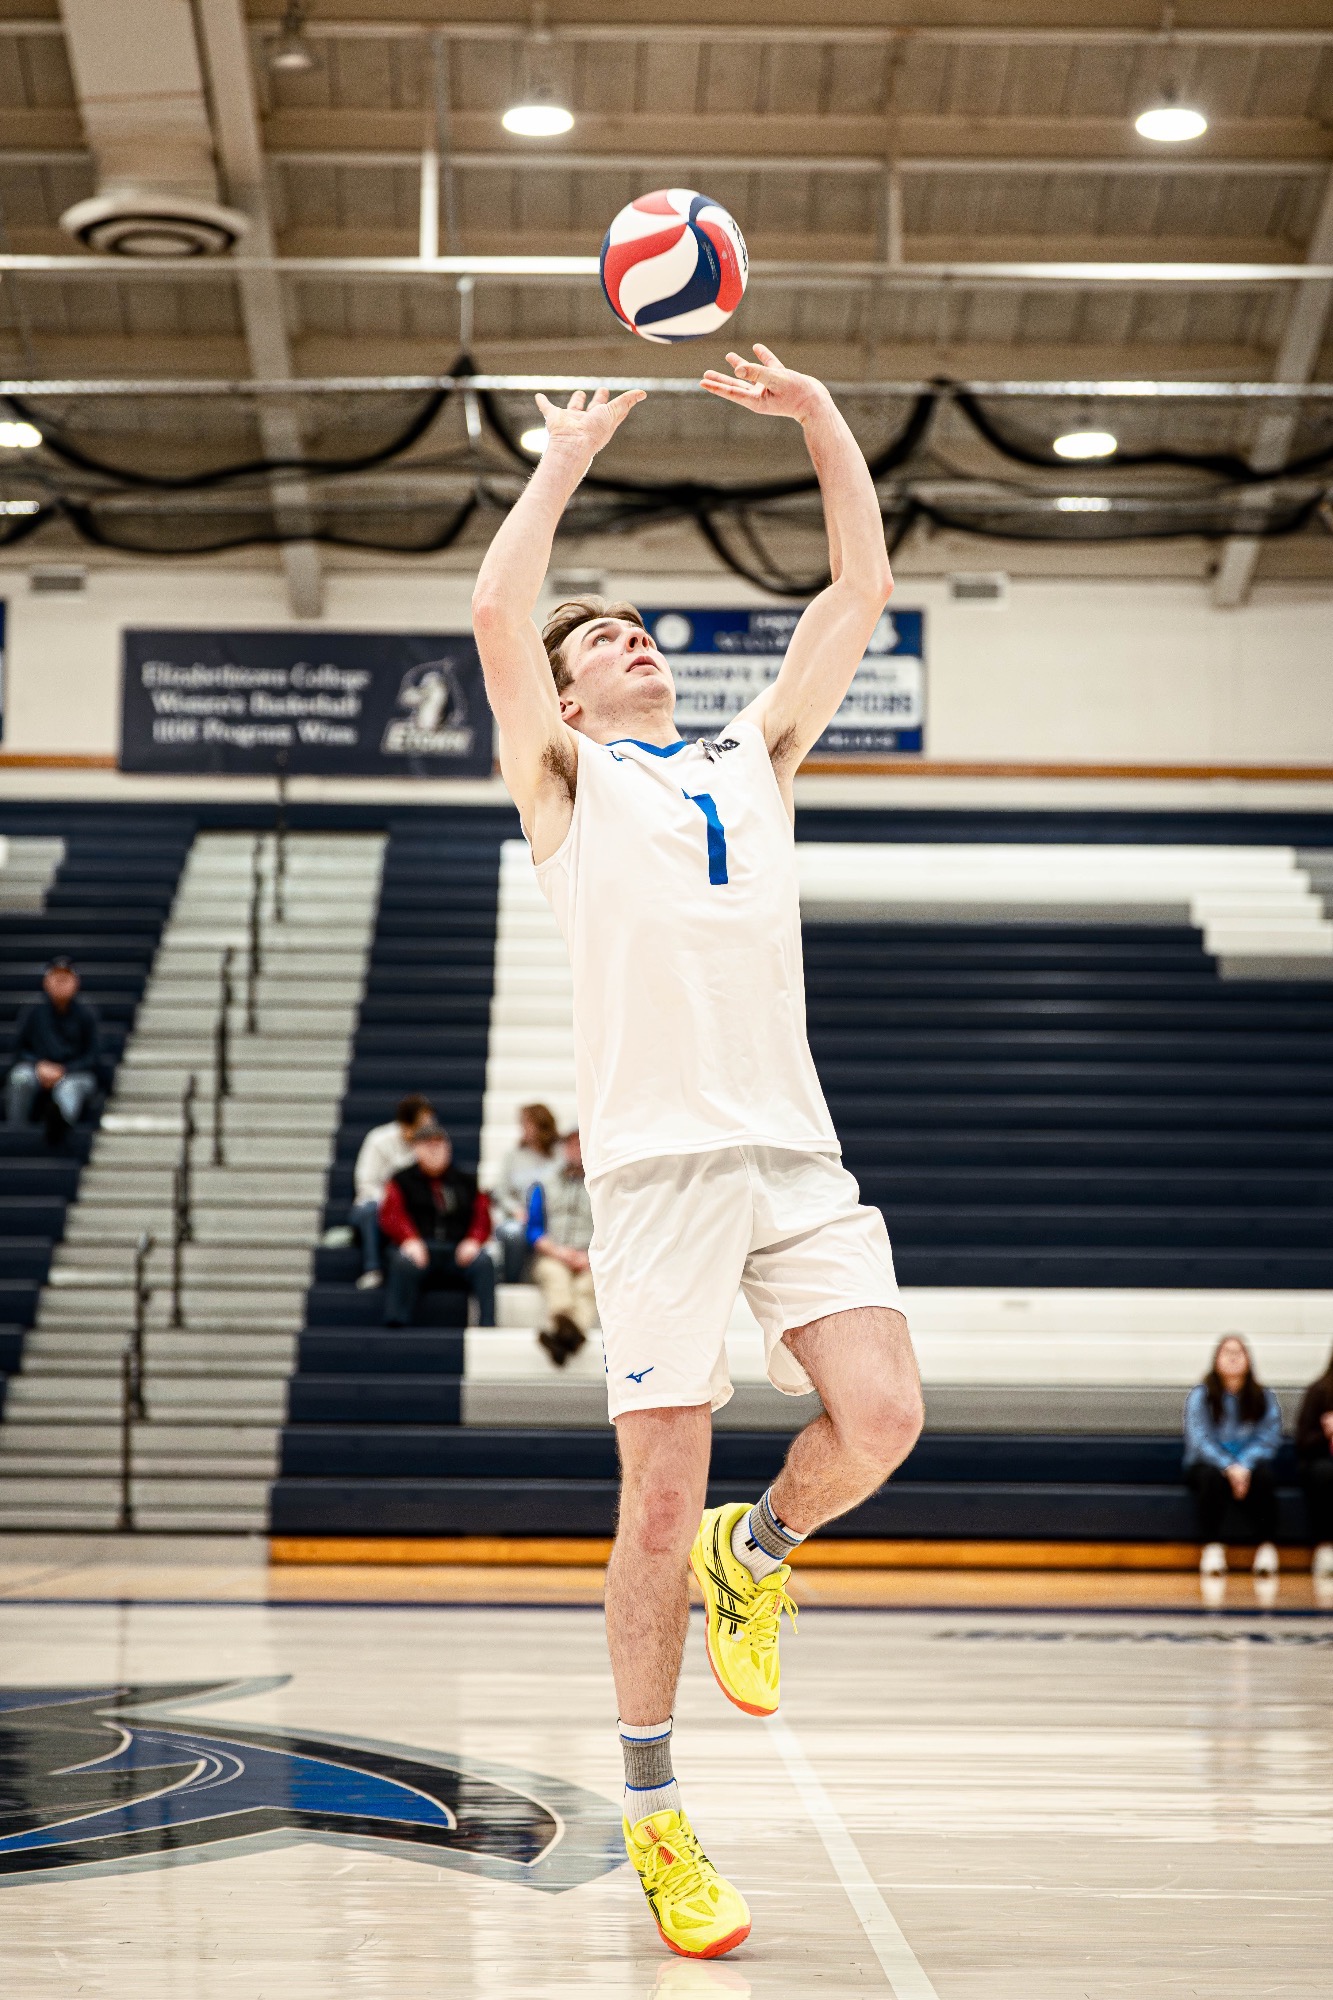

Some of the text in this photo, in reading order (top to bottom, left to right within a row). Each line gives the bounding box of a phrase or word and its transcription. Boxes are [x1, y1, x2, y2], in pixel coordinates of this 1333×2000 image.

[250, 692, 362, 718] Basketball
[202, 719, 292, 748] Program
[681, 788, 728, 885] 1
